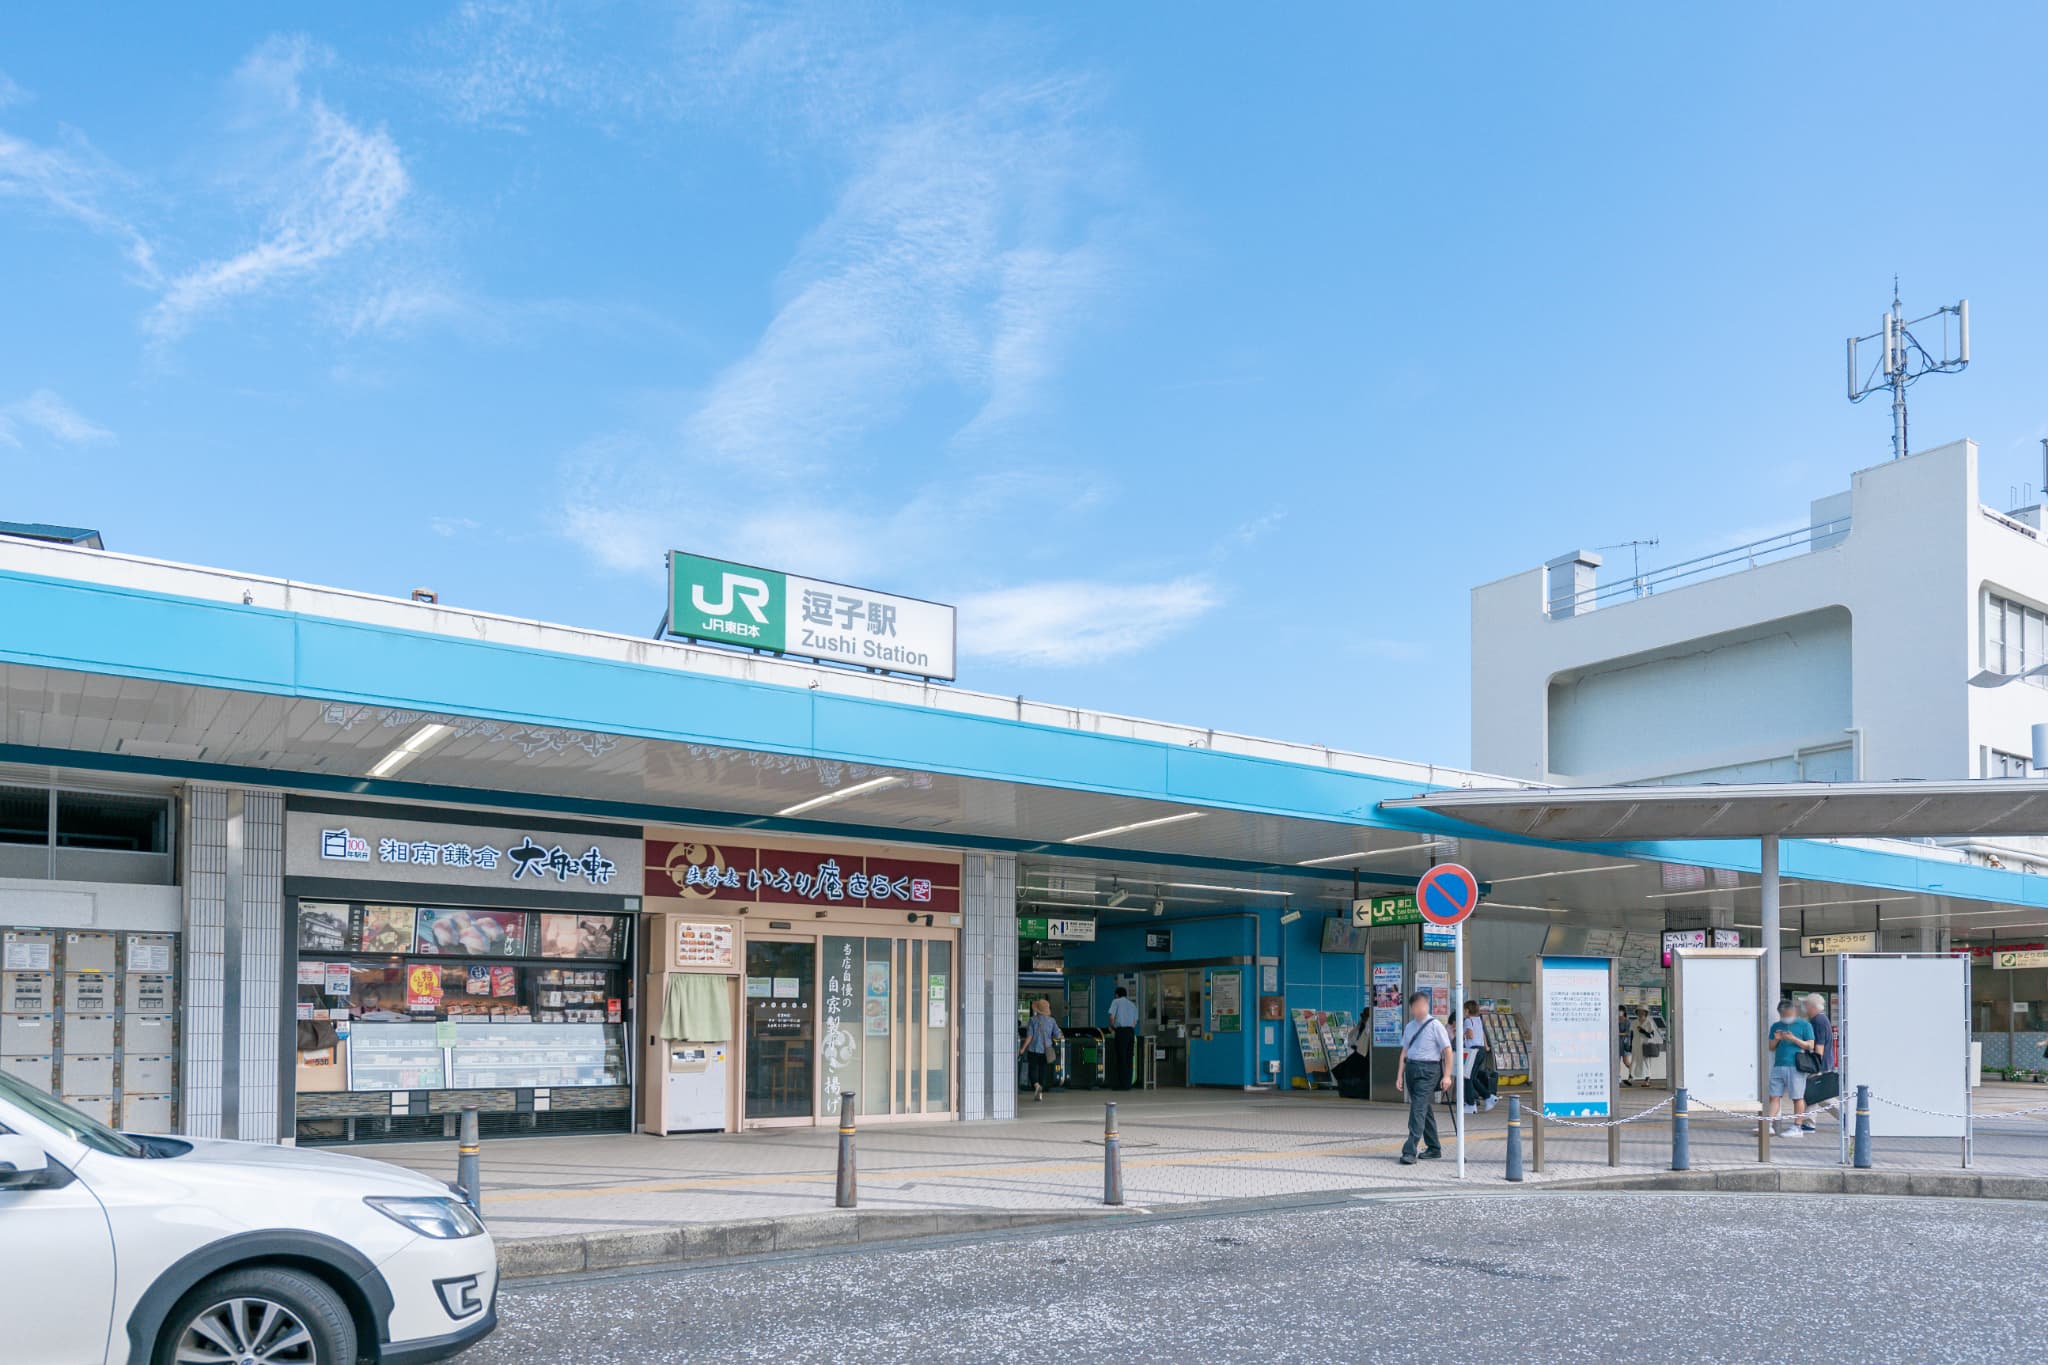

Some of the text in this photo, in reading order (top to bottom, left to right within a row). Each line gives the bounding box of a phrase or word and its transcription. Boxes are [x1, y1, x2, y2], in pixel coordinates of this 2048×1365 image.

[691, 572, 770, 624] JR
[801, 588, 897, 638] 逗子駅
[702, 617, 760, 639] JR東日本
[801, 628, 929, 667] Zushi Station
[347, 838, 365, 851] 100
[380, 836, 616, 884] 湘南鎌倉 大船軒
[686, 865, 741, 888] 生蕎麦
[1374, 900, 1395, 917] JR
[841, 943, 854, 1008] 当店自慢の
